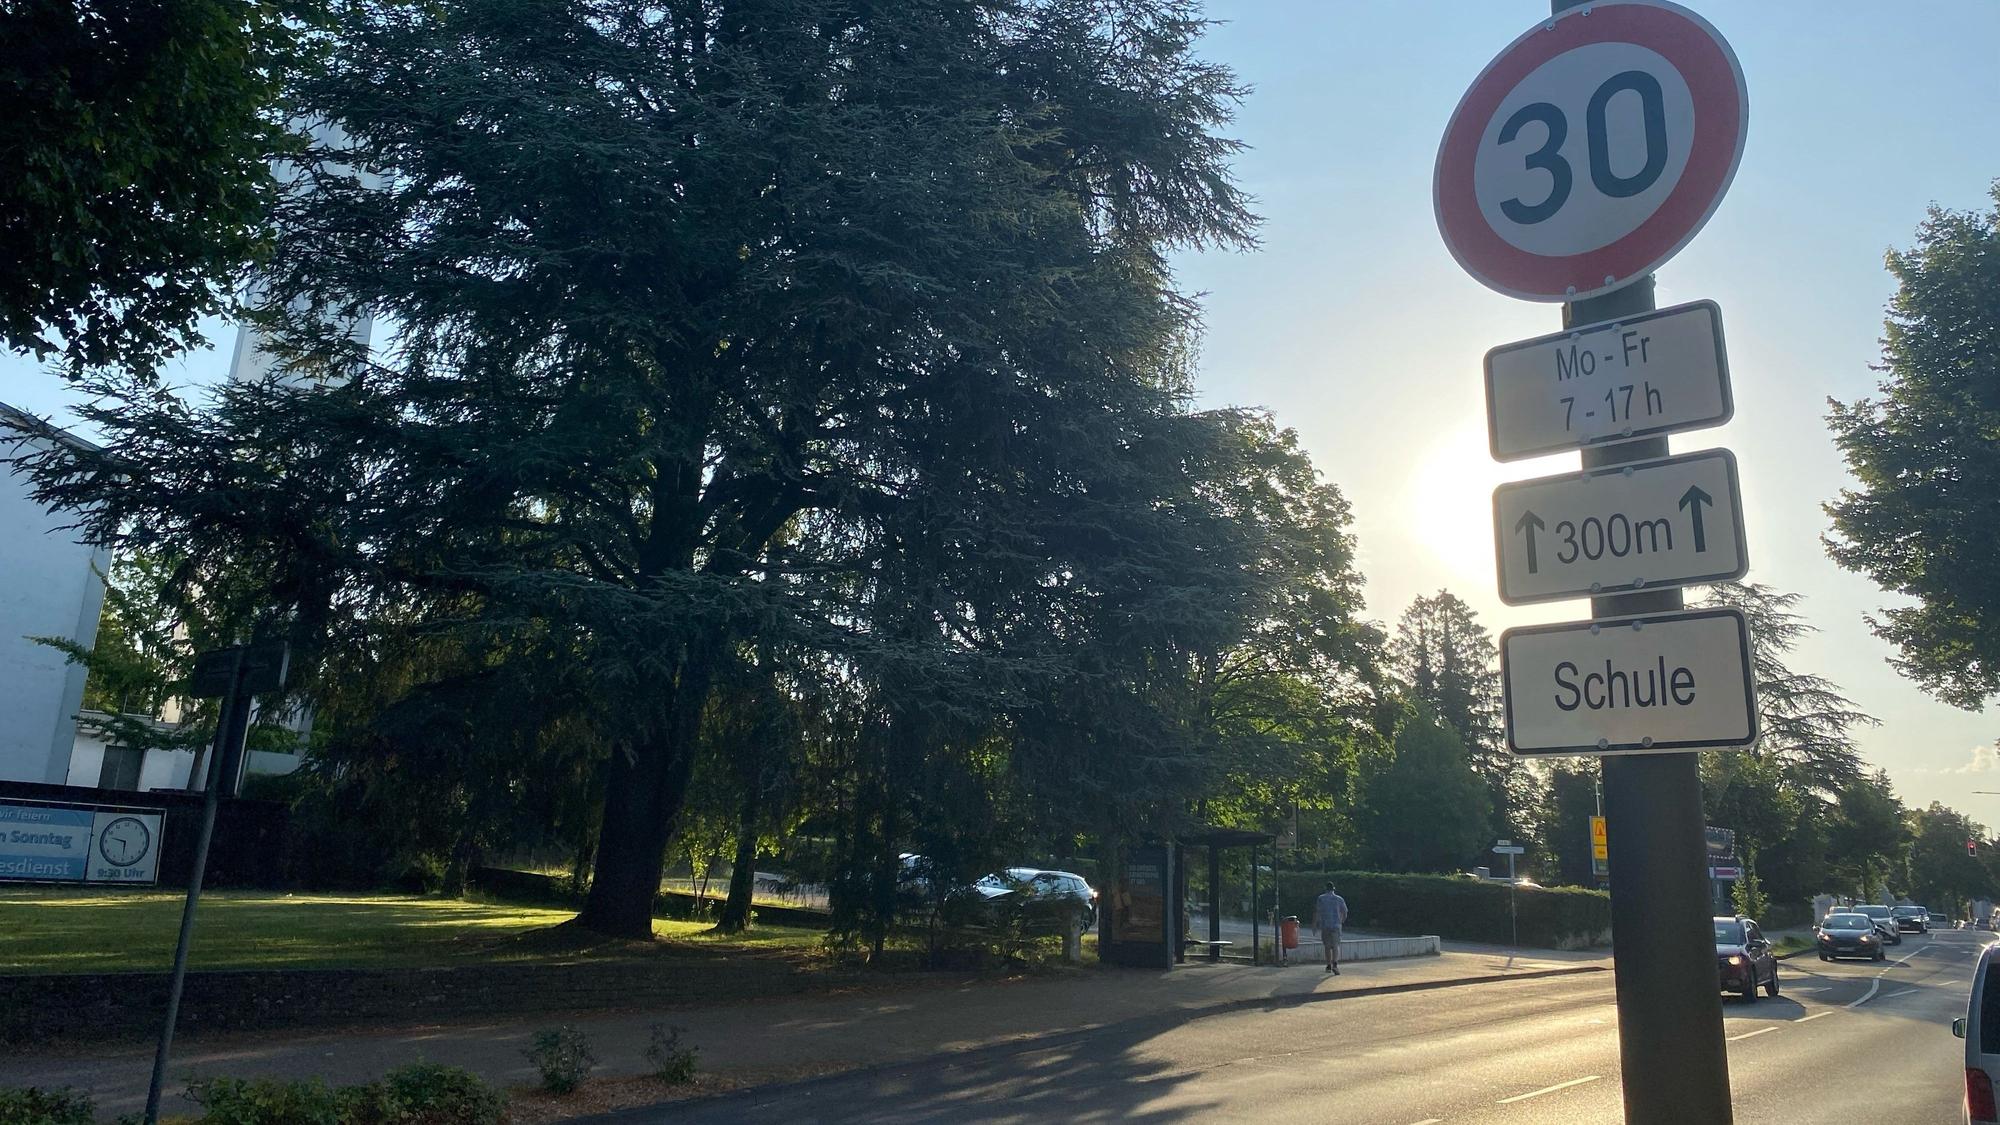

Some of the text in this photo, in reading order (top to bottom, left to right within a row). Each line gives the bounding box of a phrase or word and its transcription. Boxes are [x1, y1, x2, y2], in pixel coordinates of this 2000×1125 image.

[1497, 70, 1668, 224] 30
[1556, 345, 1596, 381] Mo
[1622, 331, 1651, 367] Fr
[1560, 397, 1575, 431] 7
[1604, 385, 1634, 422] 17
[1644, 381, 1663, 416] h
[1555, 513, 1673, 564] 300m
[1554, 656, 1696, 711] Schule
[11, 831, 73, 849] Sonntag
[97, 868, 146, 878] 9:30 Uhr
